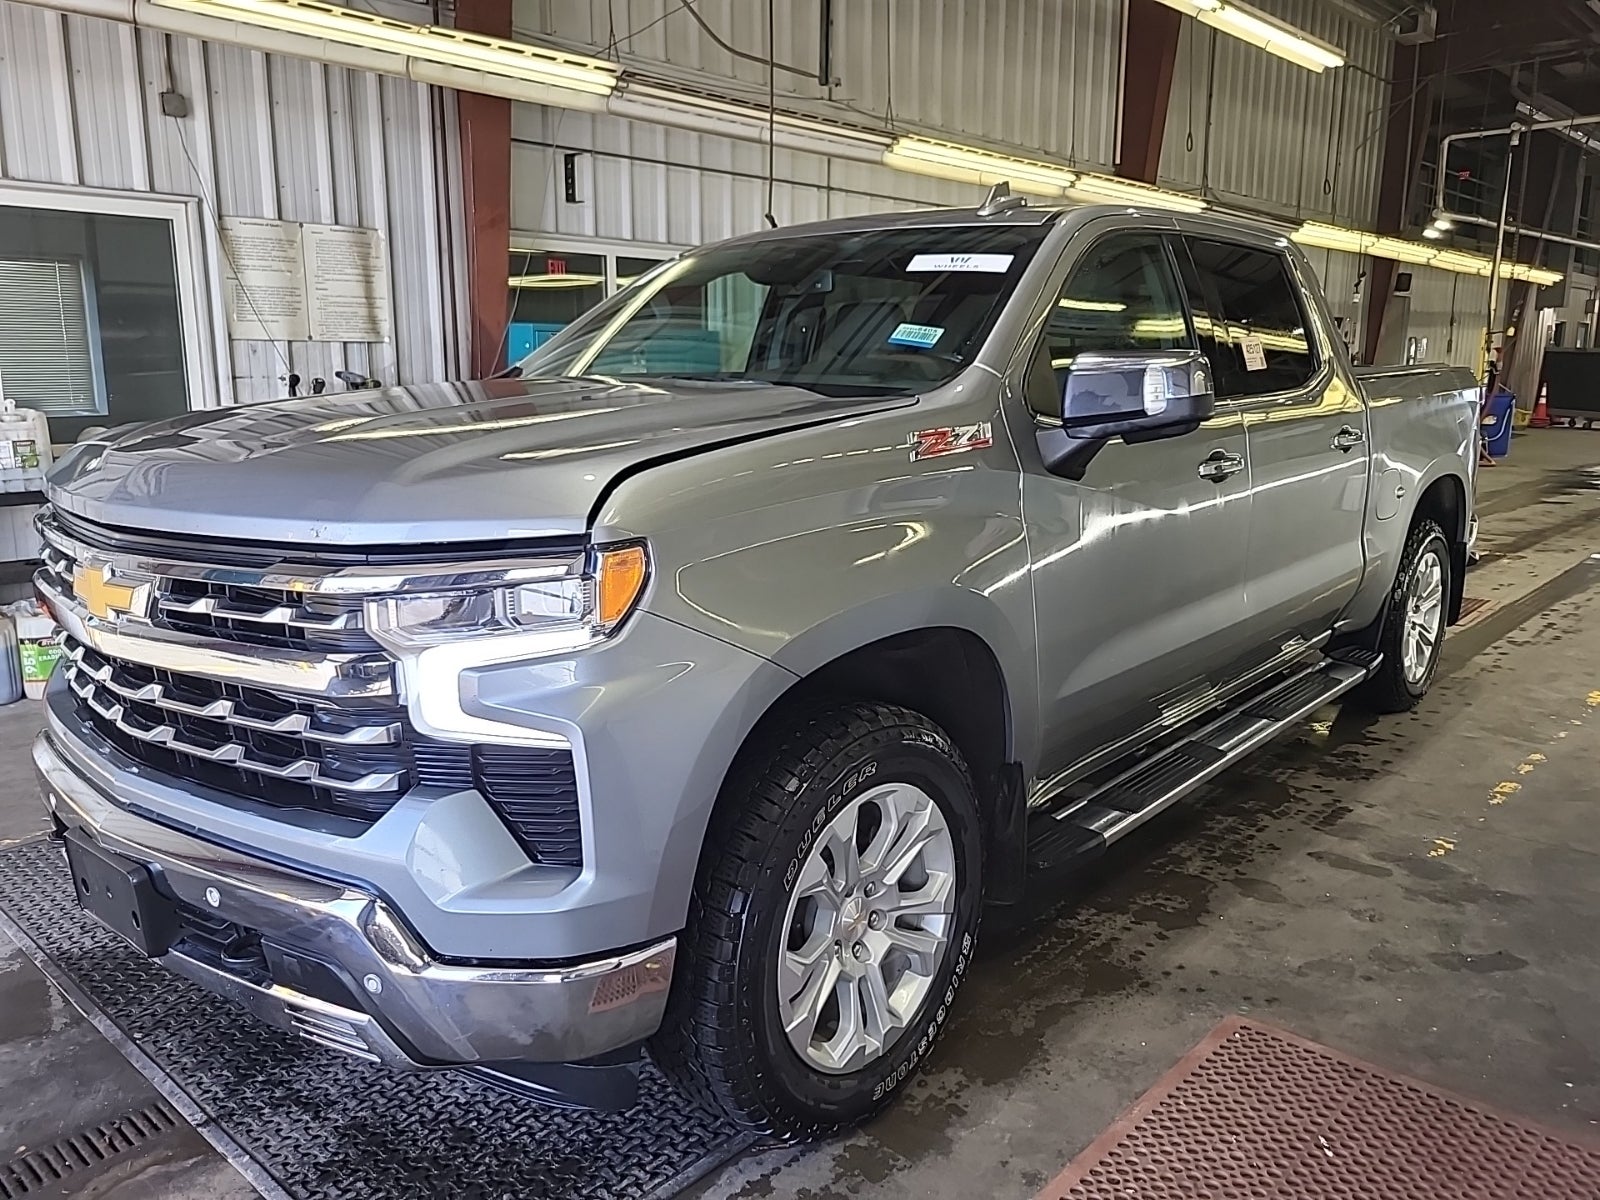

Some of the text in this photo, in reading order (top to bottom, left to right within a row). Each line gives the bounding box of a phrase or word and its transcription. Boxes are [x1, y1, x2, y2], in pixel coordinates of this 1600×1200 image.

[23, 650, 38, 674] 951
[783, 761, 877, 892] DUELER
[872, 932, 972, 1101] BRIDGESTONE
